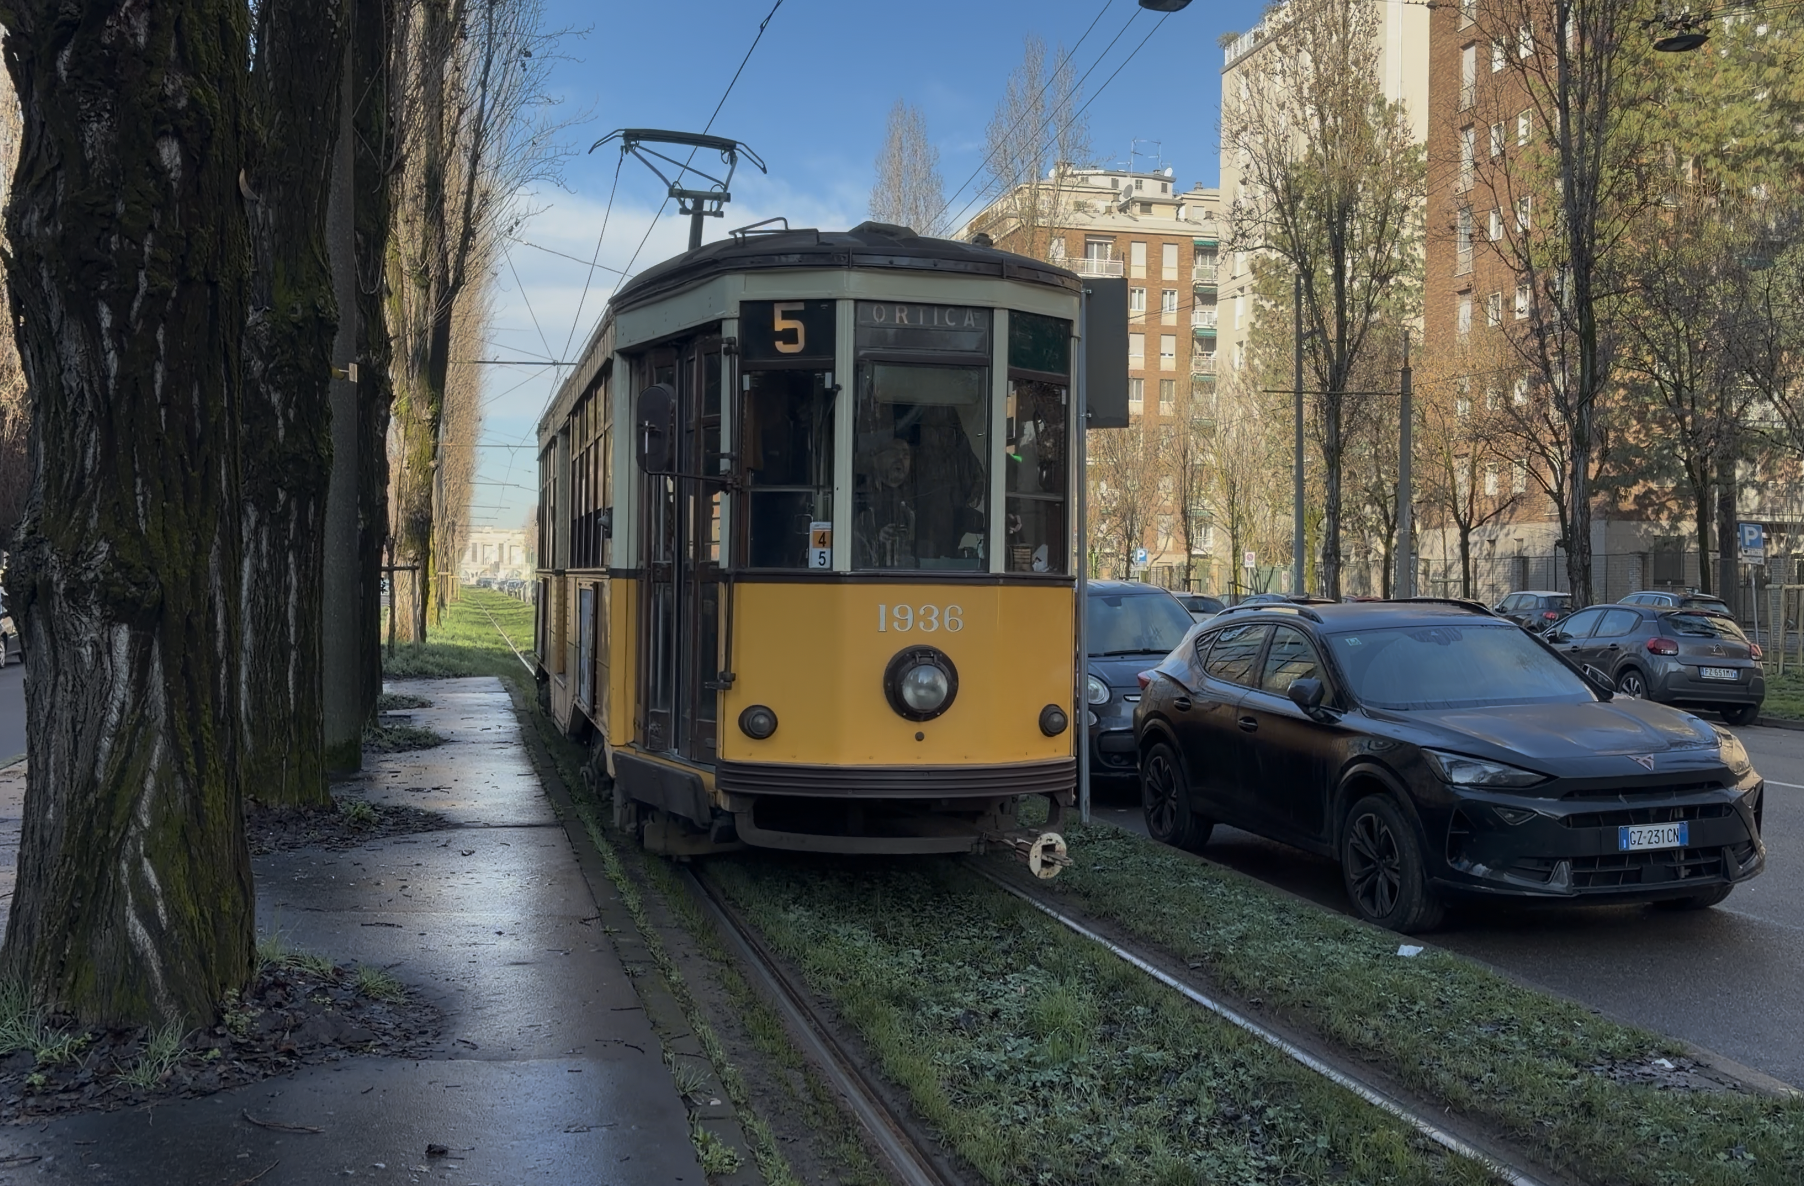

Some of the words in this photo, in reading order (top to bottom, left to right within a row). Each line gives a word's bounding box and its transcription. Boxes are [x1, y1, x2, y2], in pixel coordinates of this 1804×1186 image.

[872, 304, 976, 327] ORTICA
[774, 302, 805, 354] 5
[818, 531, 827, 548] 4
[1744, 526, 1759, 546] P
[818, 551, 827, 567] 5
[1137, 549, 1146, 561] P
[878, 604, 965, 633] 1936
